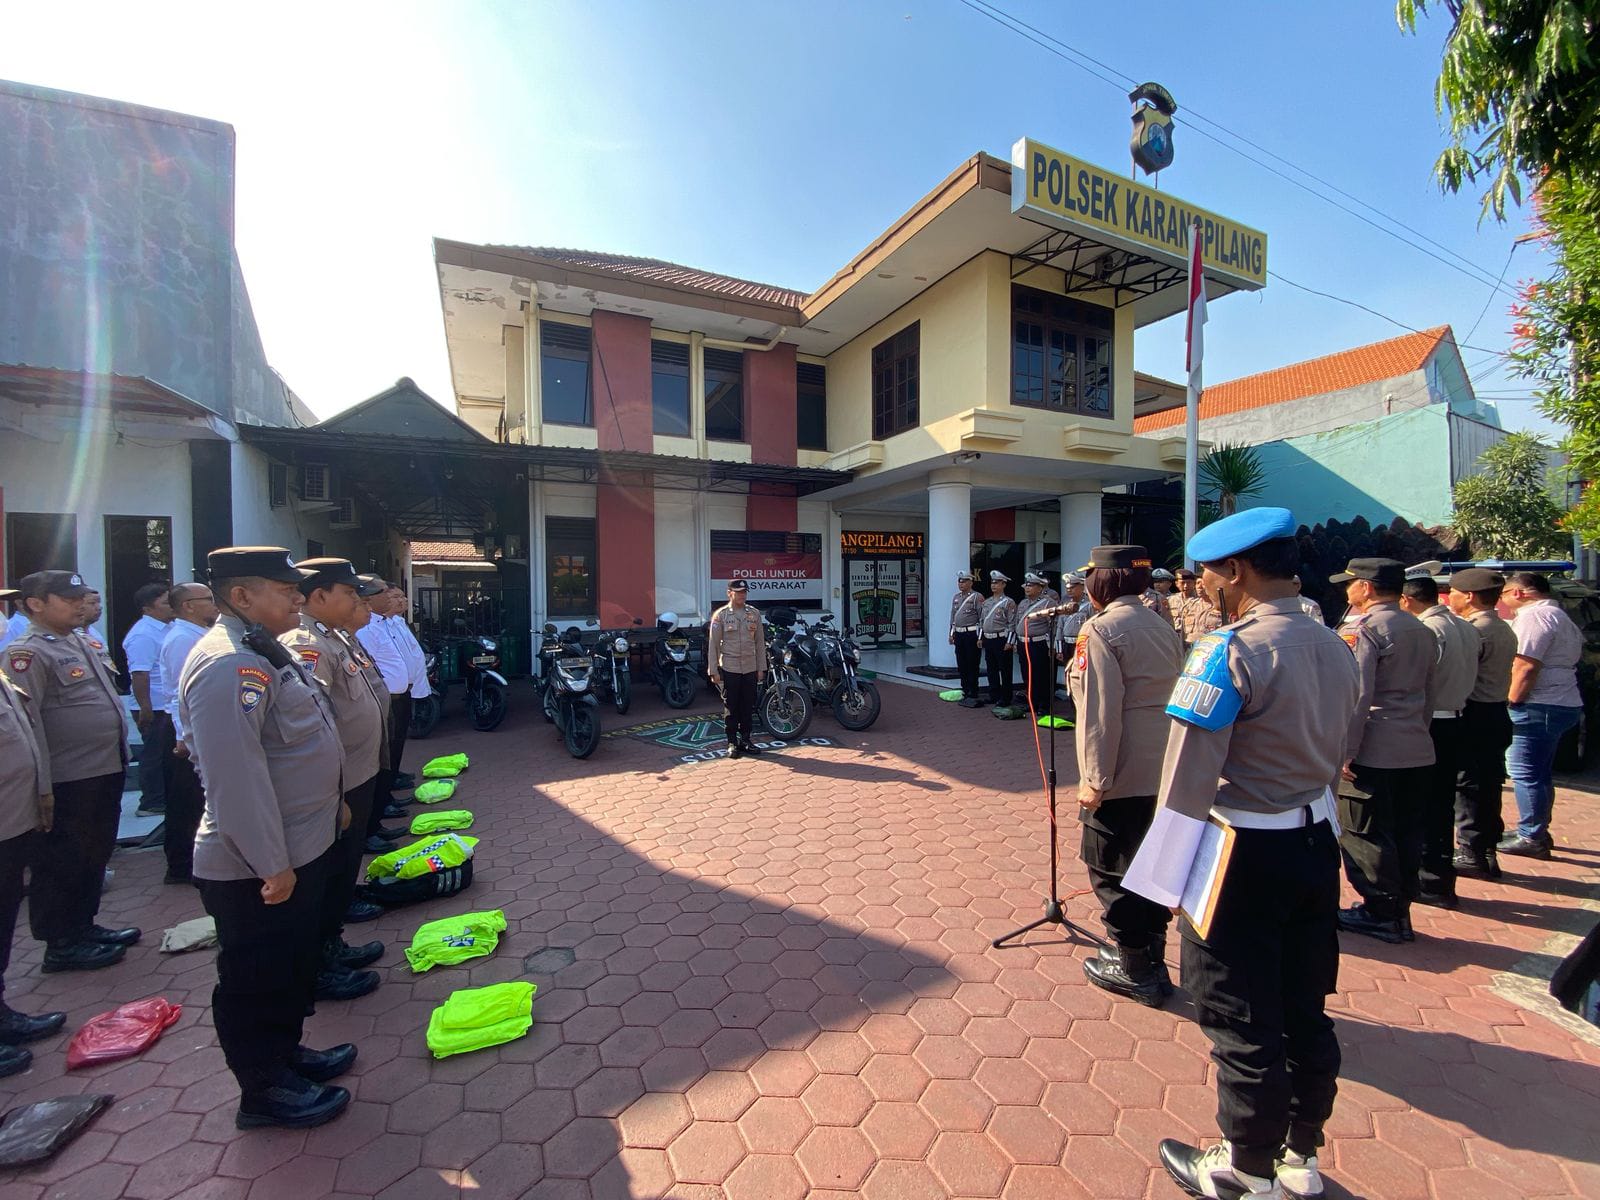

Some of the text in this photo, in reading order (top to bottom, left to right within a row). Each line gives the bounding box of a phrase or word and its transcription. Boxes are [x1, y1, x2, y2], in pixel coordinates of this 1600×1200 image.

[1033, 151, 1118, 226] POLSEK
[733, 569, 807, 578] POLRI UNTUK
